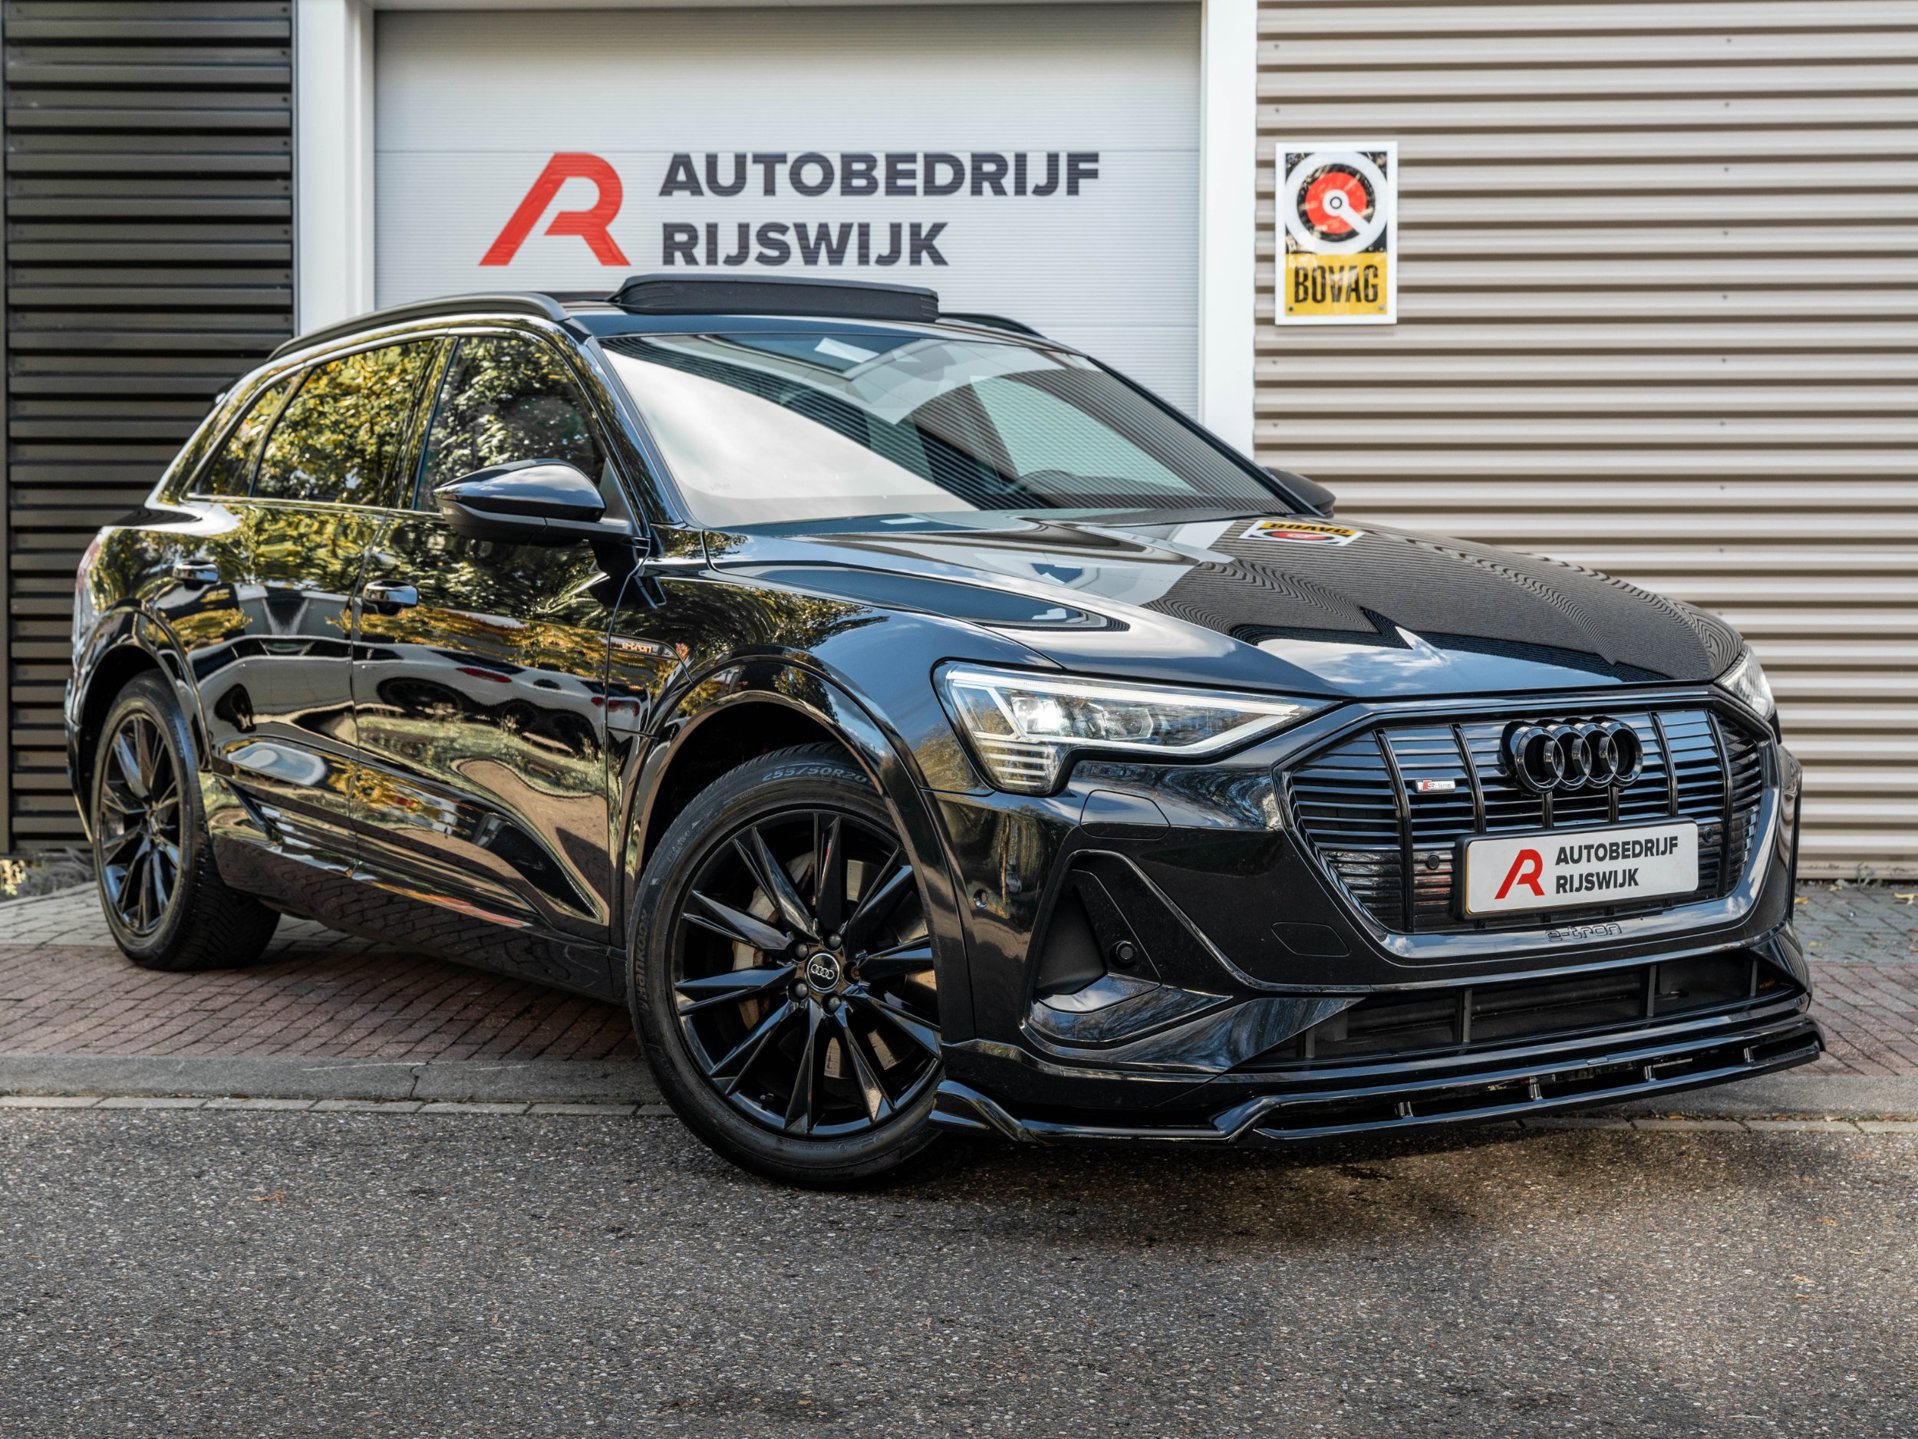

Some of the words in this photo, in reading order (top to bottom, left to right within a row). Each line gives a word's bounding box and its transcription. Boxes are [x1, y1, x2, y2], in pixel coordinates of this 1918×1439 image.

[658, 152, 1099, 197] AUTOBEDRIJF
[661, 222, 949, 266] RIJSWIJK
[1294, 264, 1379, 303] BOVAG
[1555, 836, 1678, 866] AUTOBEDRIJF
[1555, 868, 1639, 894] RIJSWIJK
[1546, 922, 1623, 943] e-tron
